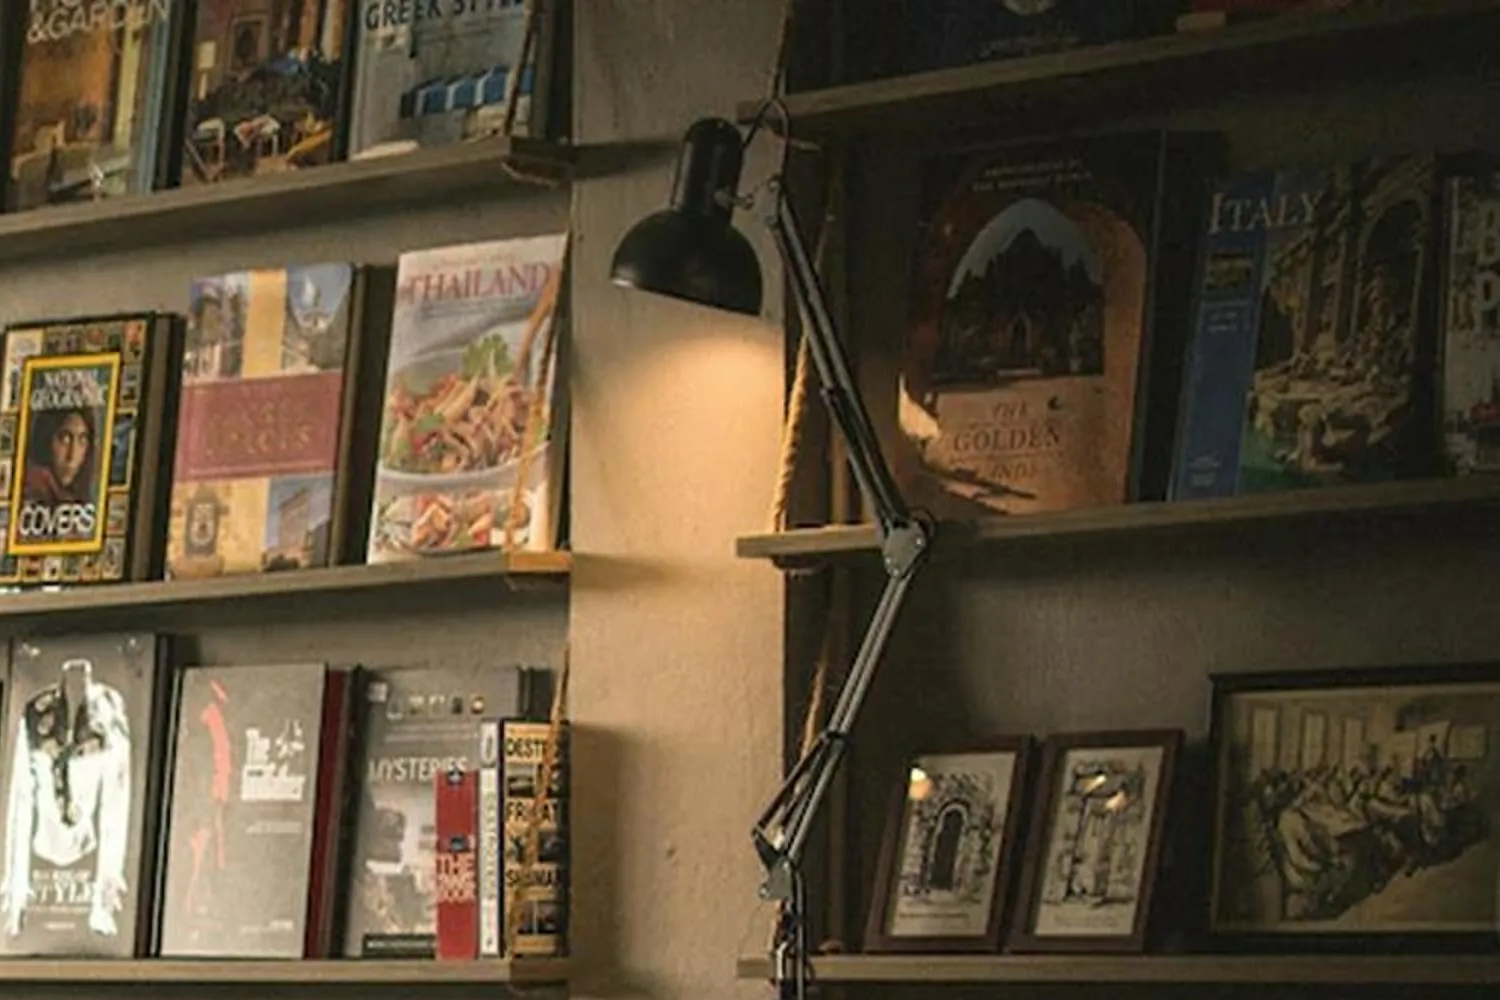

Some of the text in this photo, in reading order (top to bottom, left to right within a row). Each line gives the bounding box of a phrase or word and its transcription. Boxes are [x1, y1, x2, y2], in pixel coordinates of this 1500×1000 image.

[1207, 191, 1322, 235] ITALY
[404, 262, 551, 305] THAILAND
[953, 421, 1060, 452] GOLDEN
[19, 502, 97, 537] COVERS
